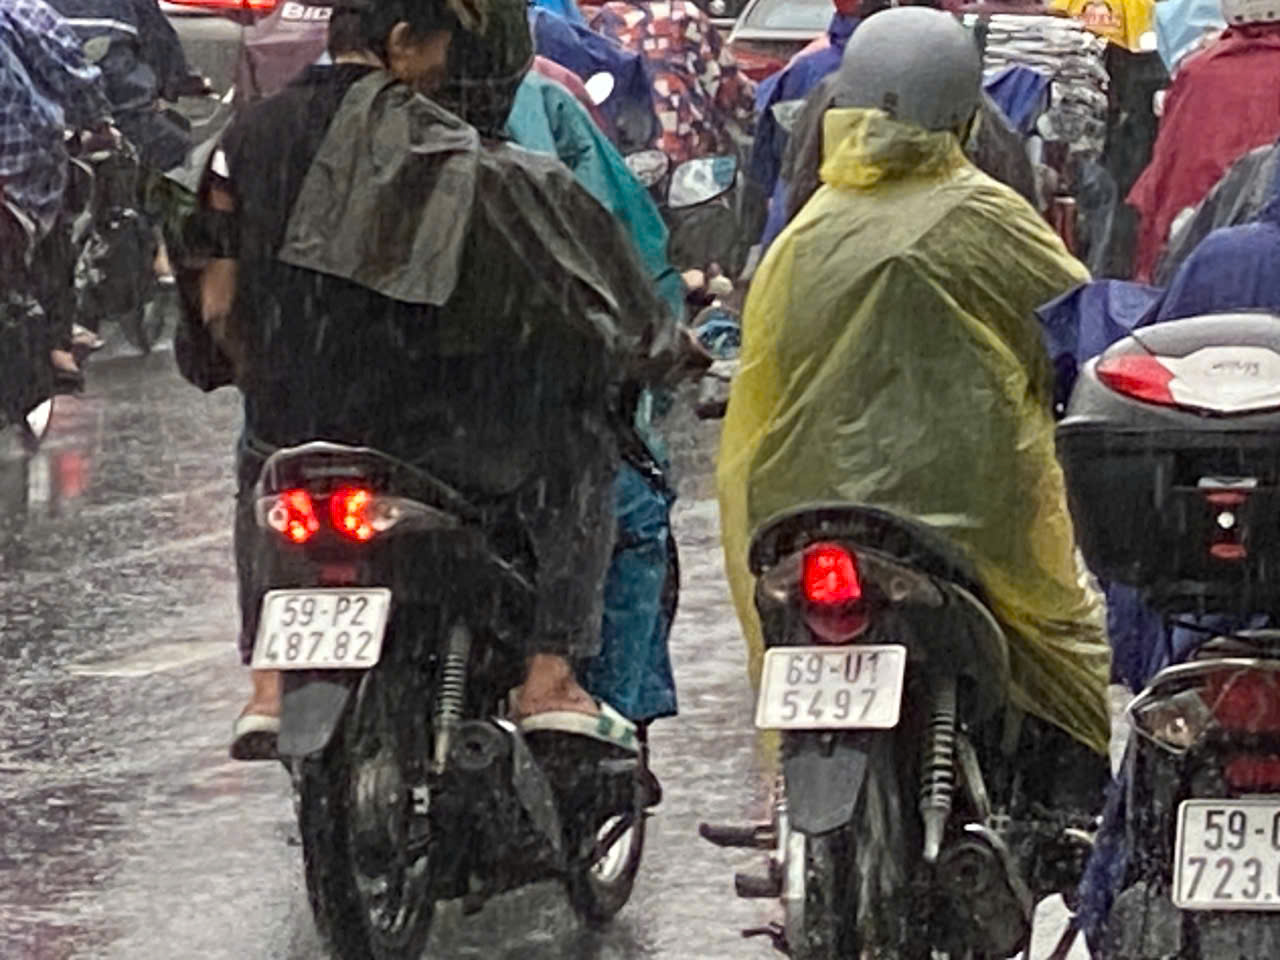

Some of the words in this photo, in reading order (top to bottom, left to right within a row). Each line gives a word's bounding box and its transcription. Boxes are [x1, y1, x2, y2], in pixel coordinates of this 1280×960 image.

[282, 596, 369, 627] 59-P2
[264, 631, 373, 661] 487.82
[786, 653, 880, 685] 69-U1
[780, 688, 879, 720] 5497
